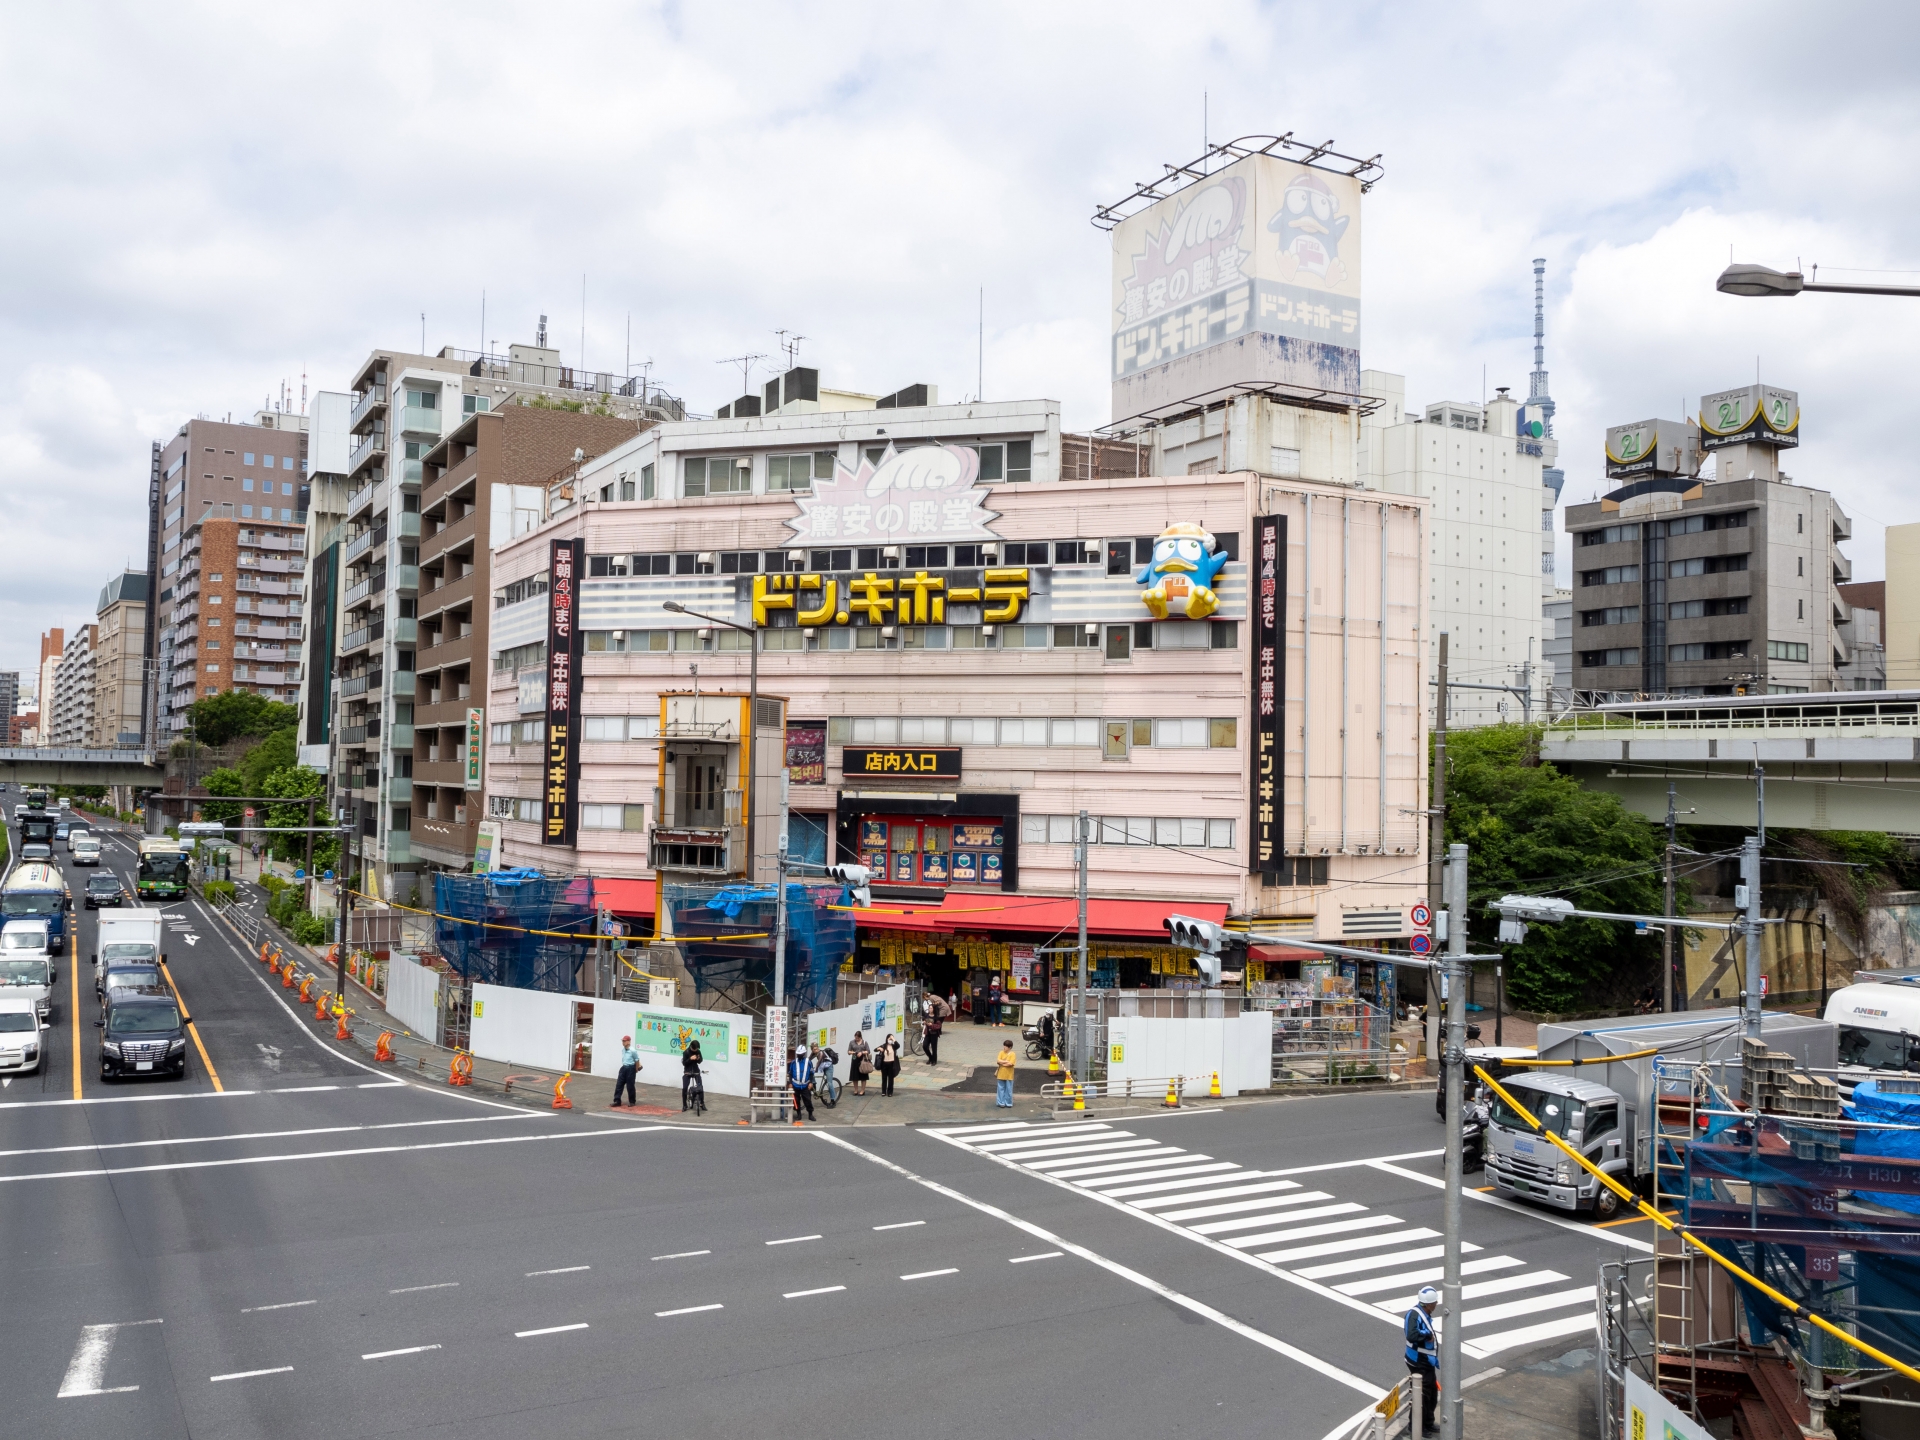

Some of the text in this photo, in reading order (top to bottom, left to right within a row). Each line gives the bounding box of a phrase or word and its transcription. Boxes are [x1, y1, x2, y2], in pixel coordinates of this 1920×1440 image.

[1125, 245, 1240, 324] 驚安の殿堂
[1718, 400, 1741, 429] 21
[1772, 400, 1788, 427] 21
[1621, 432, 1641, 459] 21
[1705, 431, 1755, 447] PLAZA
[809, 498, 973, 538] 驚安の殿堂
[1262, 526, 1276, 629] 早朝4時まで
[555, 549, 572, 637] 早朝4時まで
[551, 652, 569, 711] 年中無休
[1260, 647, 1274, 715] 年中無休
[865, 752, 937, 771] 店内入口
[1869, 1167, 1901, 1183] H30
[1813, 1258, 1832, 1272] 35
